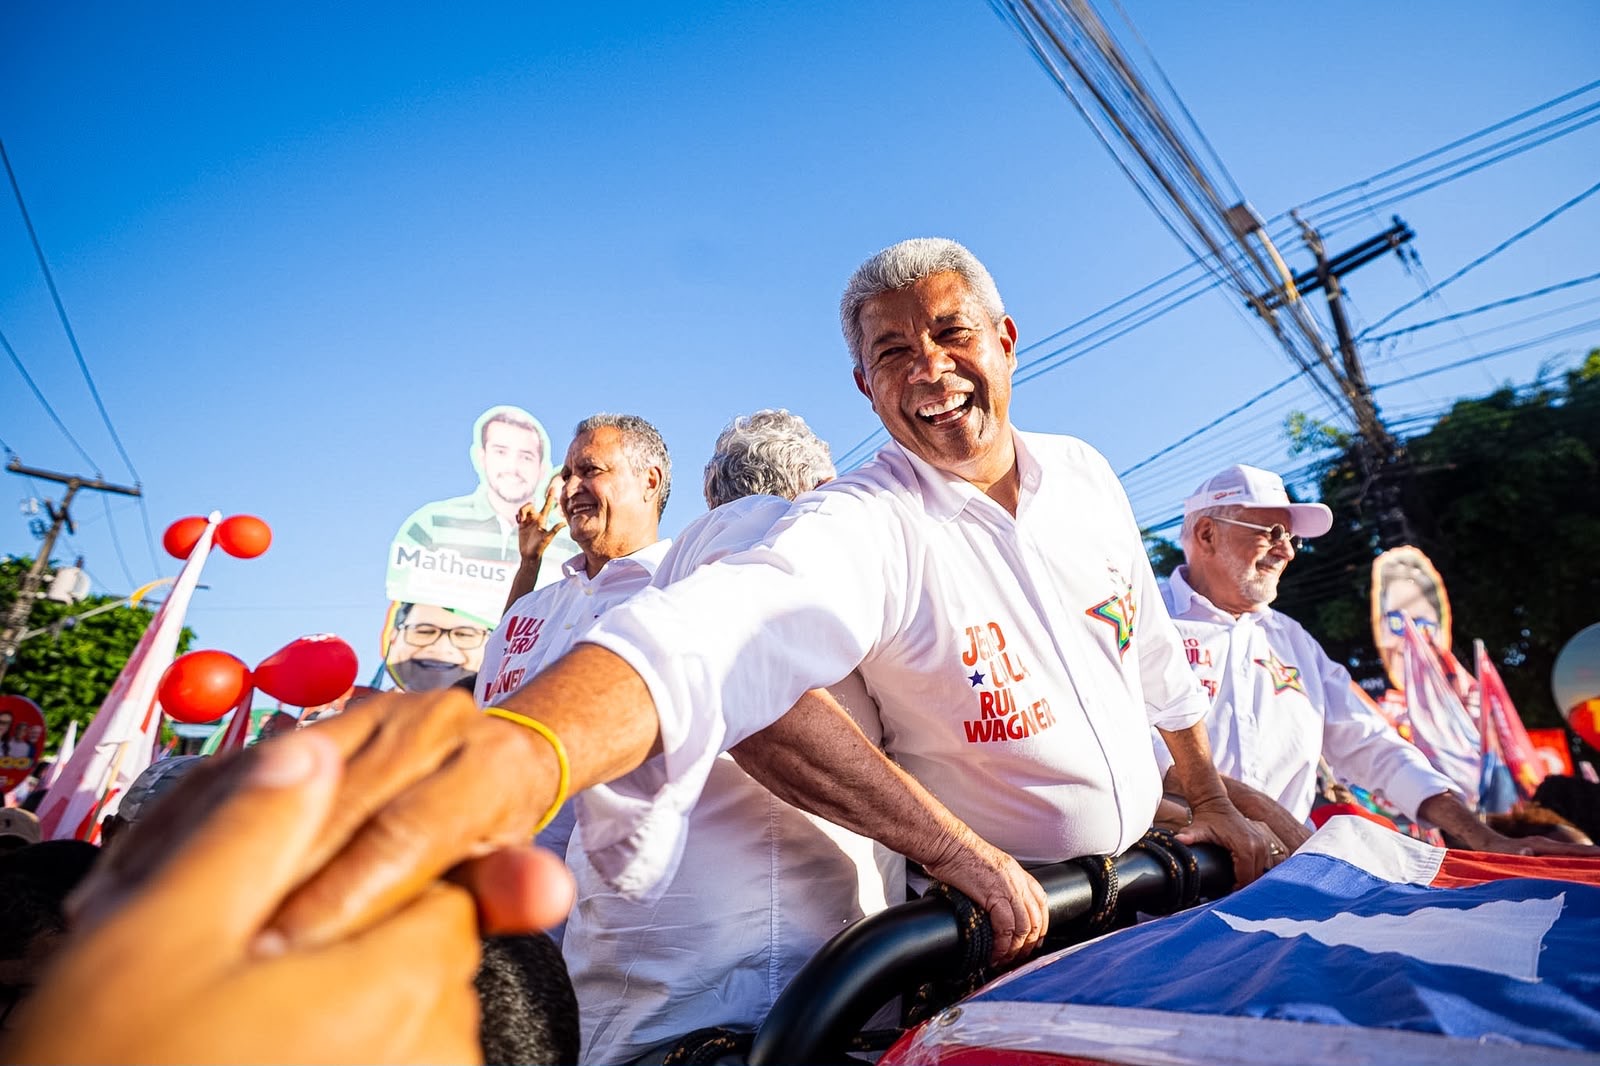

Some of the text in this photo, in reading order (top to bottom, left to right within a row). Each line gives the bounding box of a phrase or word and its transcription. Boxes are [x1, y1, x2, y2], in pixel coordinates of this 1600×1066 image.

[396, 547, 507, 582] Matheus
[963, 697, 1057, 743] WAGNER
[980, 687, 1017, 721] RUI
